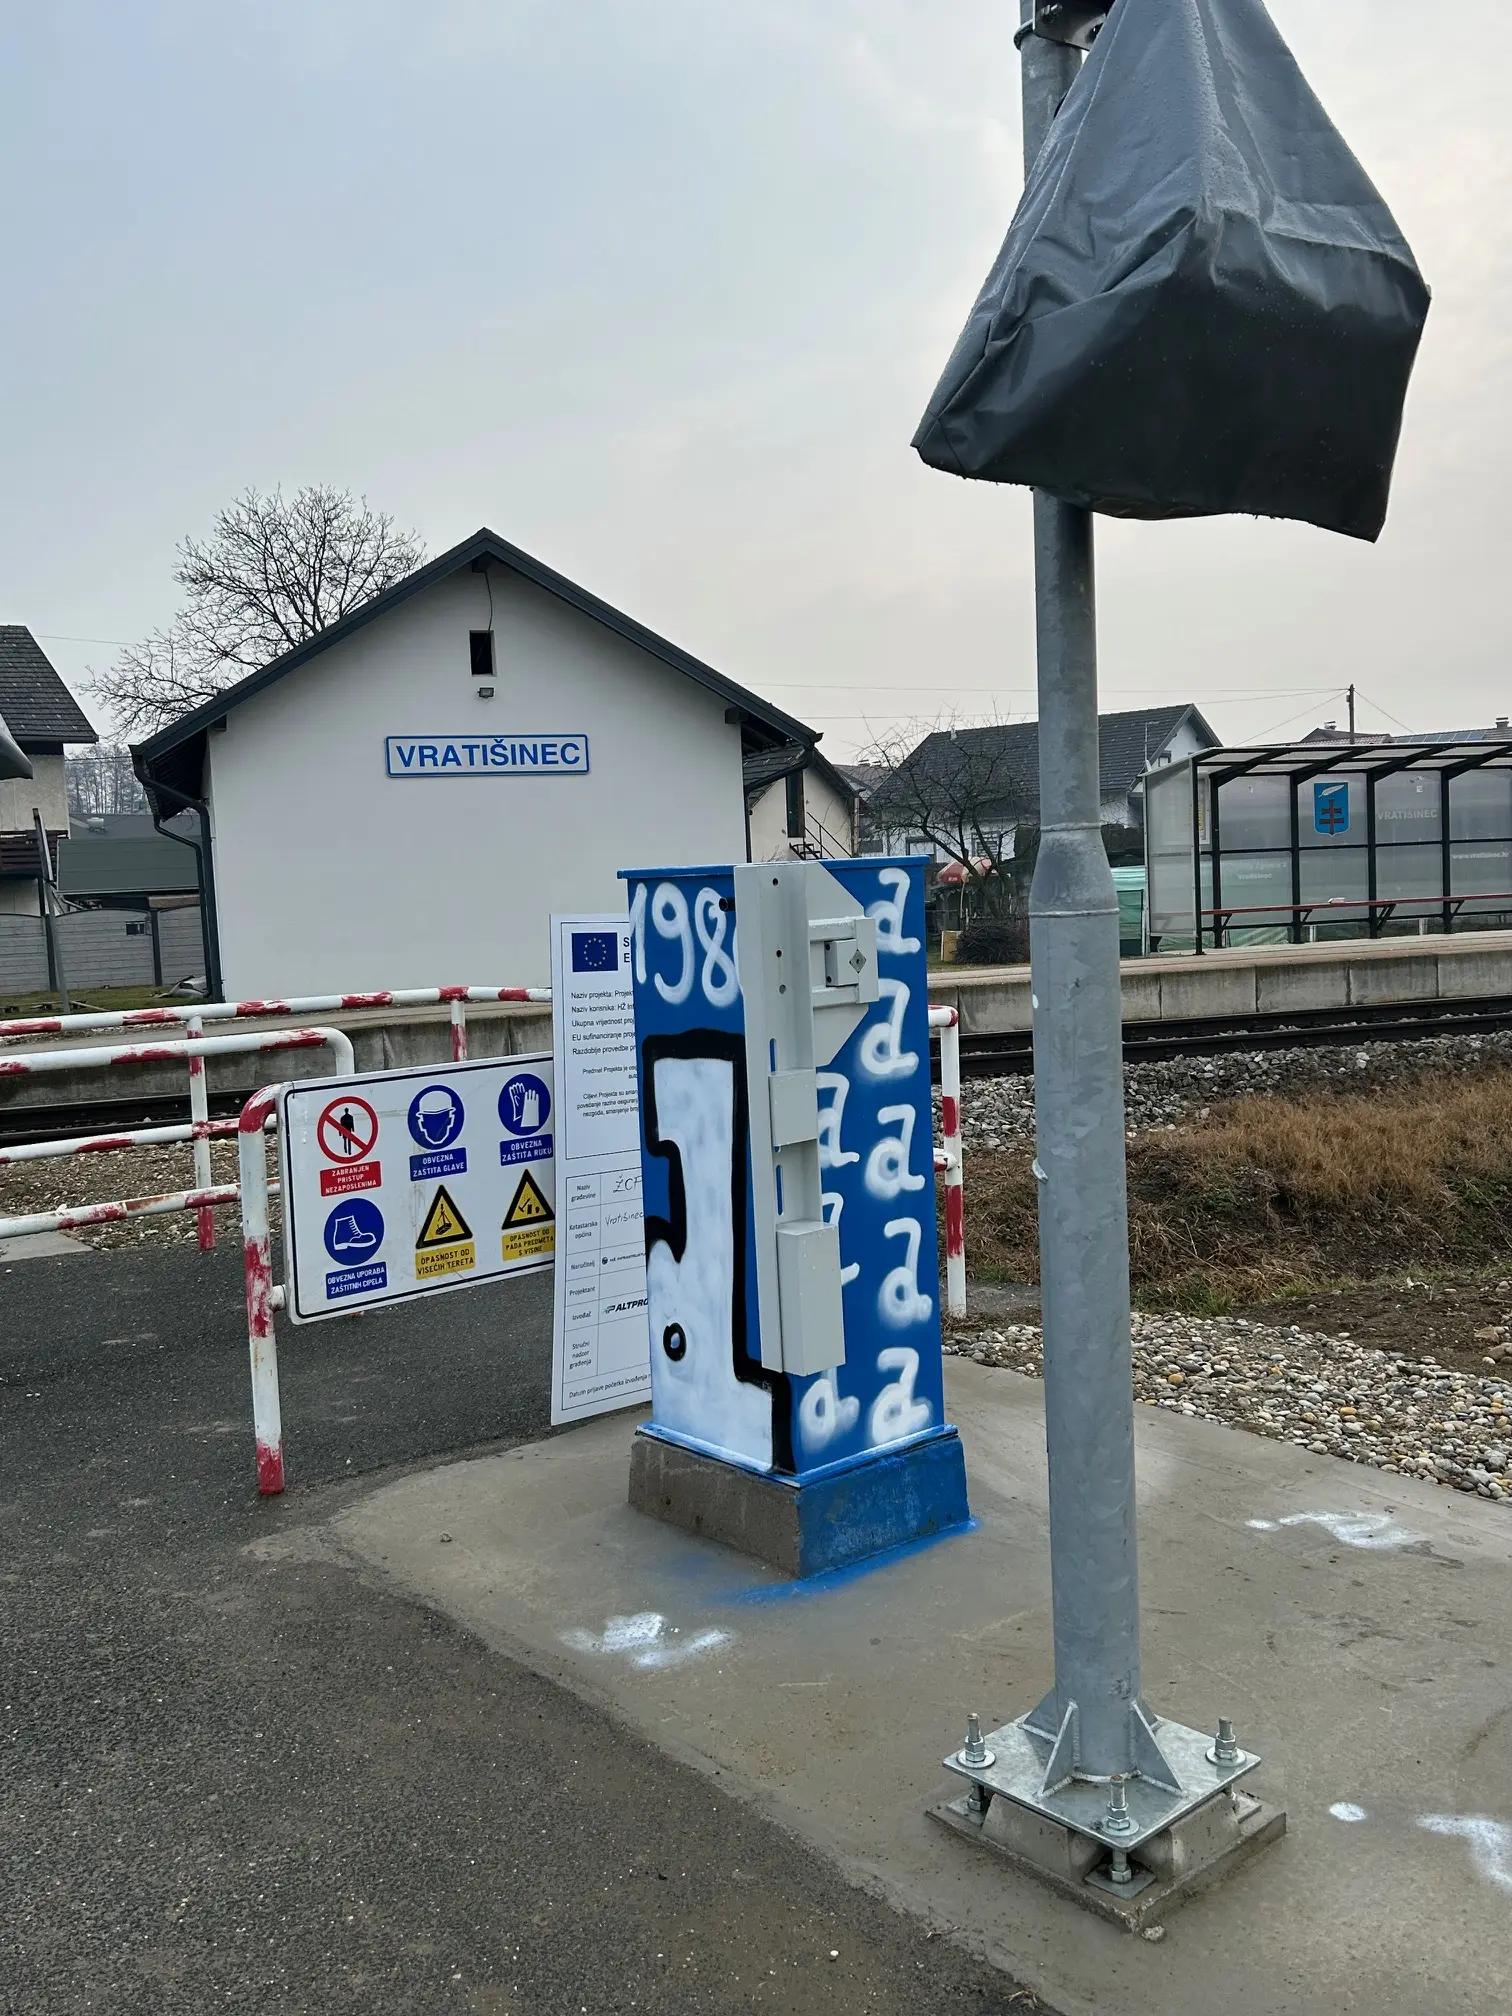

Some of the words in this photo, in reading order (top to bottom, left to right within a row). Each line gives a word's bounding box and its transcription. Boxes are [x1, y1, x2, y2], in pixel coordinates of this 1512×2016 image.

[396, 738, 580, 767] VRATIŠINEC
[629, 882, 744, 1008] 198
[588, 991, 613, 1000] projekta:
[571, 1005, 588, 1013] Naziv
[589, 1004, 616, 1012] korisnika:
[571, 1019, 594, 1028] Ukupna
[595, 1017, 623, 1027] vrijednost
[572, 1033, 582, 1041] EU
[582, 1031, 622, 1041] sufinanciranje
[572, 1046, 601, 1055] Razdoblje
[602, 1044, 629, 1054] provedbe
[510, 1139, 542, 1151] OBVEZNA
[533, 1146, 553, 1157] RUKU
[422, 1153, 454, 1165] OBVEZNA
[331, 1164, 370, 1177] ZABRANJEN
[443, 1161, 465, 1172] GLAVE
[337, 1173, 365, 1184] PRISTUP
[325, 1179, 377, 1194] NEZAPOSLENIMA
[509, 1229, 541, 1242] OPASNOST
[505, 1241, 522, 1251] PADA
[523, 1235, 554, 1247] PREDMETA
[420, 1250, 459, 1265] OPASNOST
[460, 1248, 470, 1257] OD
[446, 1256, 474, 1269] TERETA
[327, 1272, 356, 1285] OBVEZNA
[356, 1266, 386, 1279] UPORABA
[362, 1277, 383, 1288] CIPELA
[569, 1285, 596, 1297] Projektant
[568, 1388, 587, 1399] Datum
[586, 1385, 605, 1395] prijave
